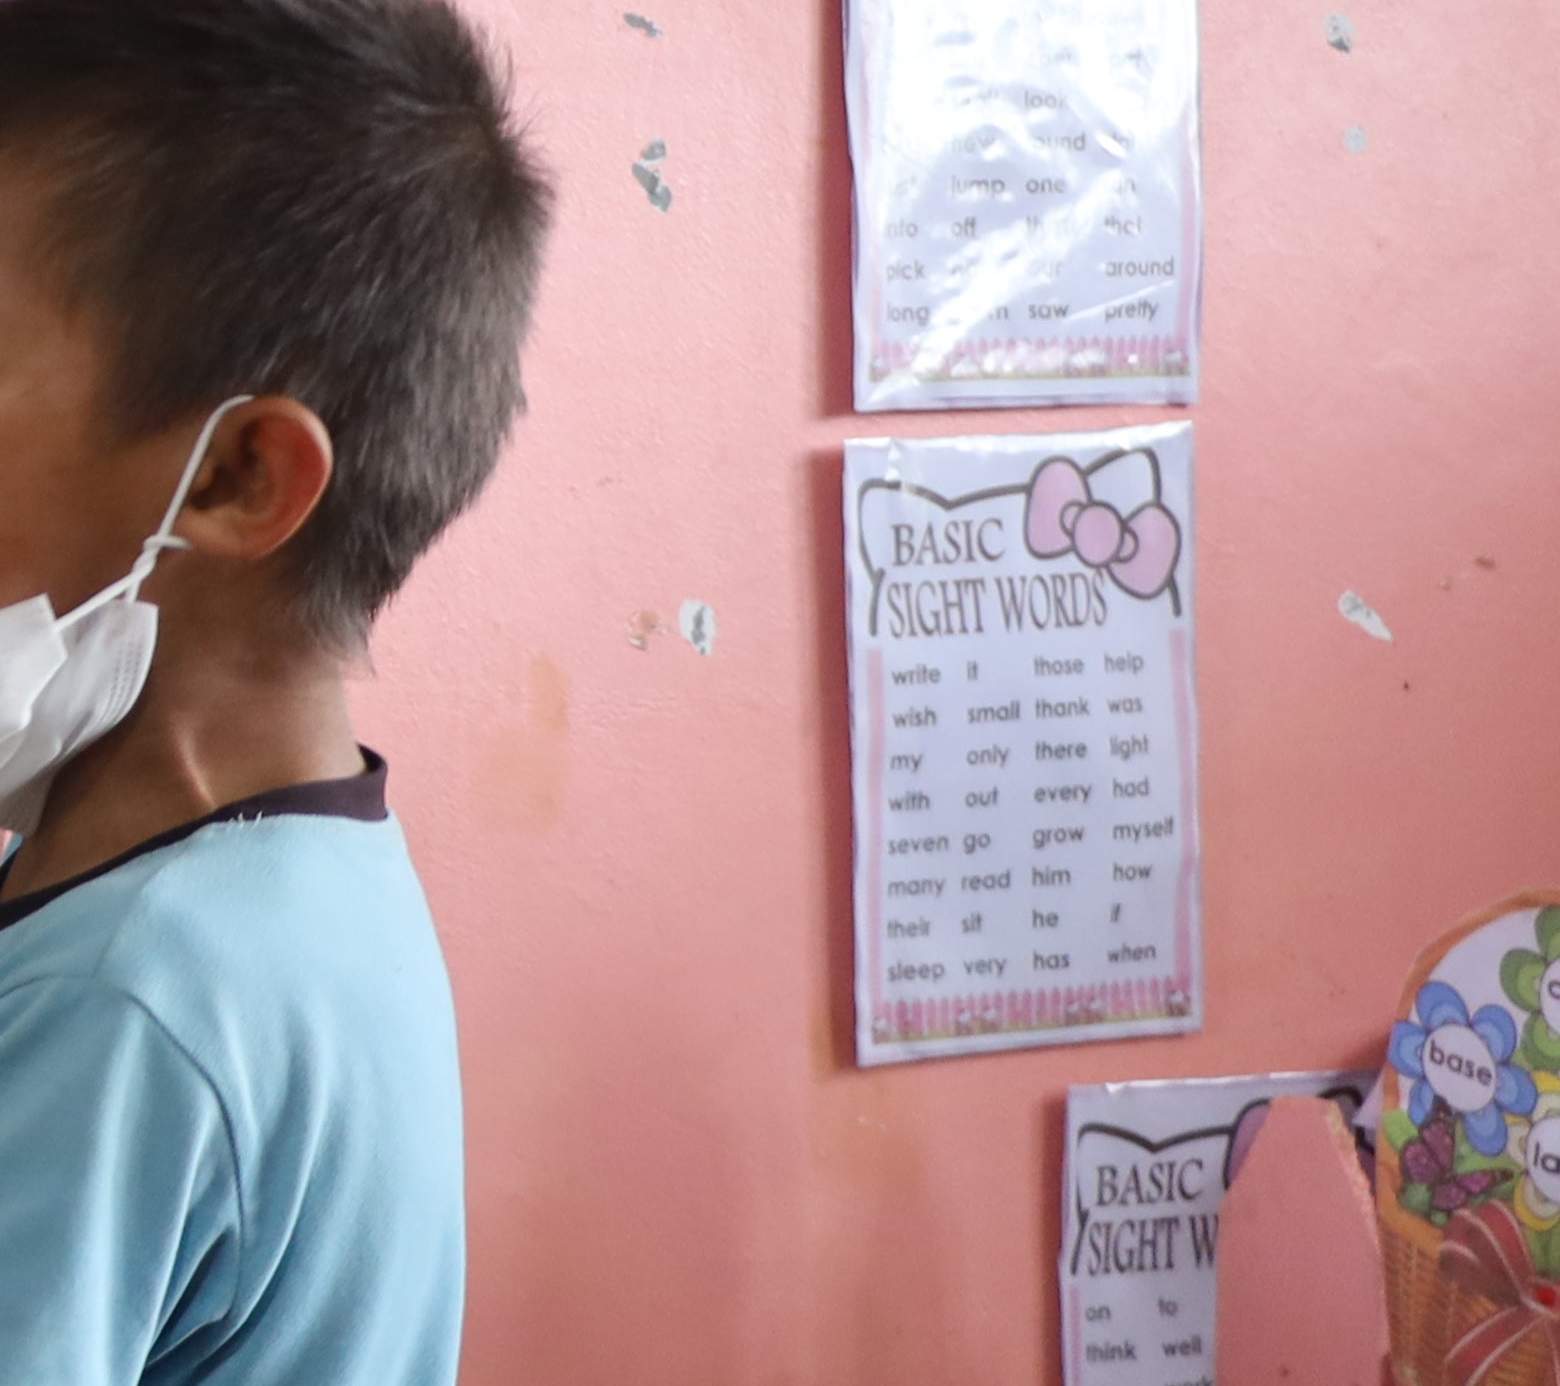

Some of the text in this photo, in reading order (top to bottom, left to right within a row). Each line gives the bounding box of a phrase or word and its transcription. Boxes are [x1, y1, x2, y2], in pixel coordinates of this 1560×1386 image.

[1025, 177, 1065, 194] one
[1104, 257, 1175, 277] around
[1028, 302, 1069, 321] saw
[891, 517, 1006, 567] BASIC
[887, 565, 1108, 639] SIGHT WORDS
[891, 652, 1145, 685] write it those help
[892, 696, 1143, 728] wish small thank was
[889, 735, 1149, 773] my only there light
[888, 776, 1150, 812] with out every had
[888, 816, 1174, 855] seven go grow myself
[887, 862, 1152, 898] many read him how
[887, 918, 930, 939] their
[961, 913, 983, 933] sit
[1032, 909, 1059, 928] he
[887, 943, 1156, 983] sleep very has when
[1428, 1040, 1492, 1087] base
[1096, 1158, 1204, 1207] BASIC
[1088, 1215, 1179, 1277] SIGHT
[1086, 1335, 1202, 1362] think well
